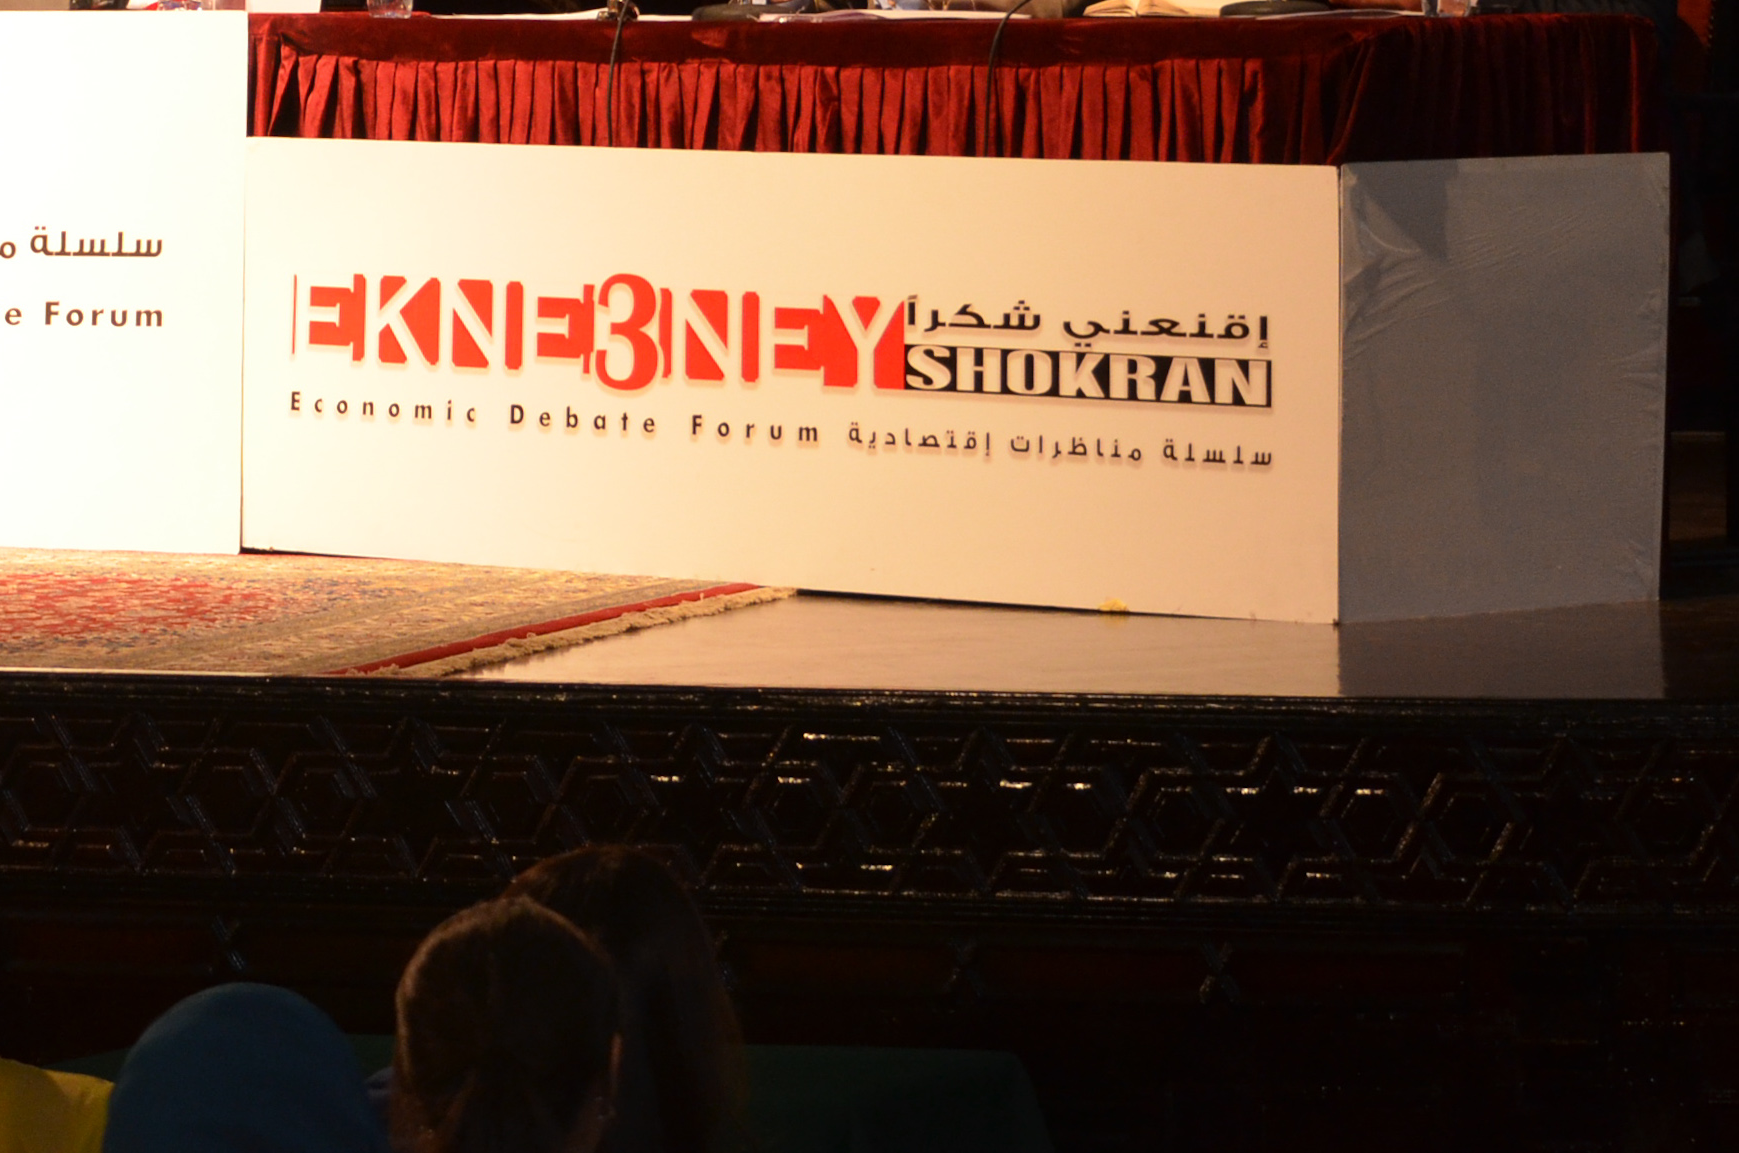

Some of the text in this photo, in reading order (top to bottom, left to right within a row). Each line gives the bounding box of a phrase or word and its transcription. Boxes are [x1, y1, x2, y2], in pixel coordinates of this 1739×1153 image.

[29, 225, 163, 258] سلسلة
[44, 301, 163, 327] Forum
[905, 344, 1272, 407] SHOKRAN
[291, 391, 819, 443] Economic Debate Forum
[848, 421, 1273, 467] سلسلة مناظرات إقتصادية
